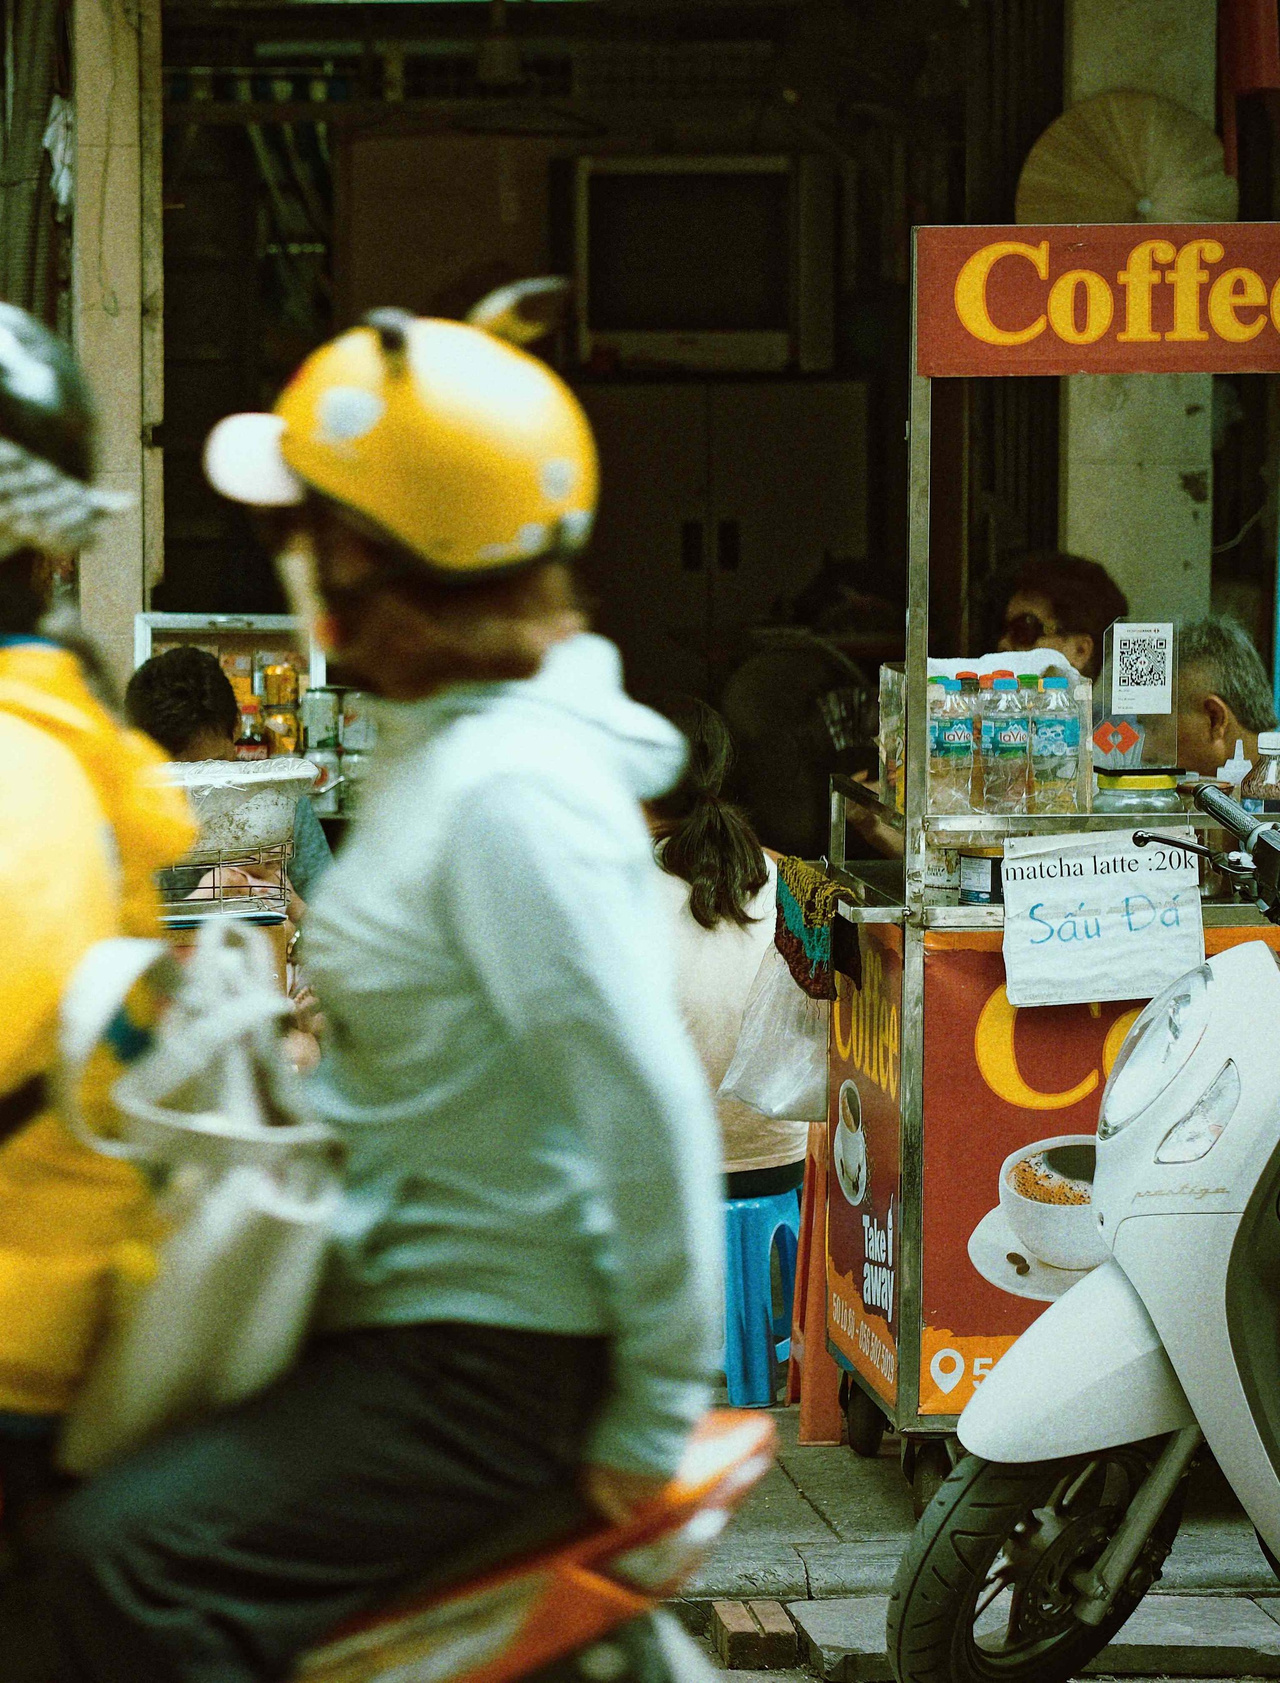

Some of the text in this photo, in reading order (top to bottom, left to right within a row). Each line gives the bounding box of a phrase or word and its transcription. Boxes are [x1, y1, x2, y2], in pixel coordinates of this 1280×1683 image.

[954, 238, 1280, 346] Coffe
[999, 730, 1027, 742] laVie
[1005, 857, 1084, 881] matcha
[1093, 855, 1139, 876] latte
[862, 1214, 887, 1263] Take
[863, 1262, 894, 1323] away
